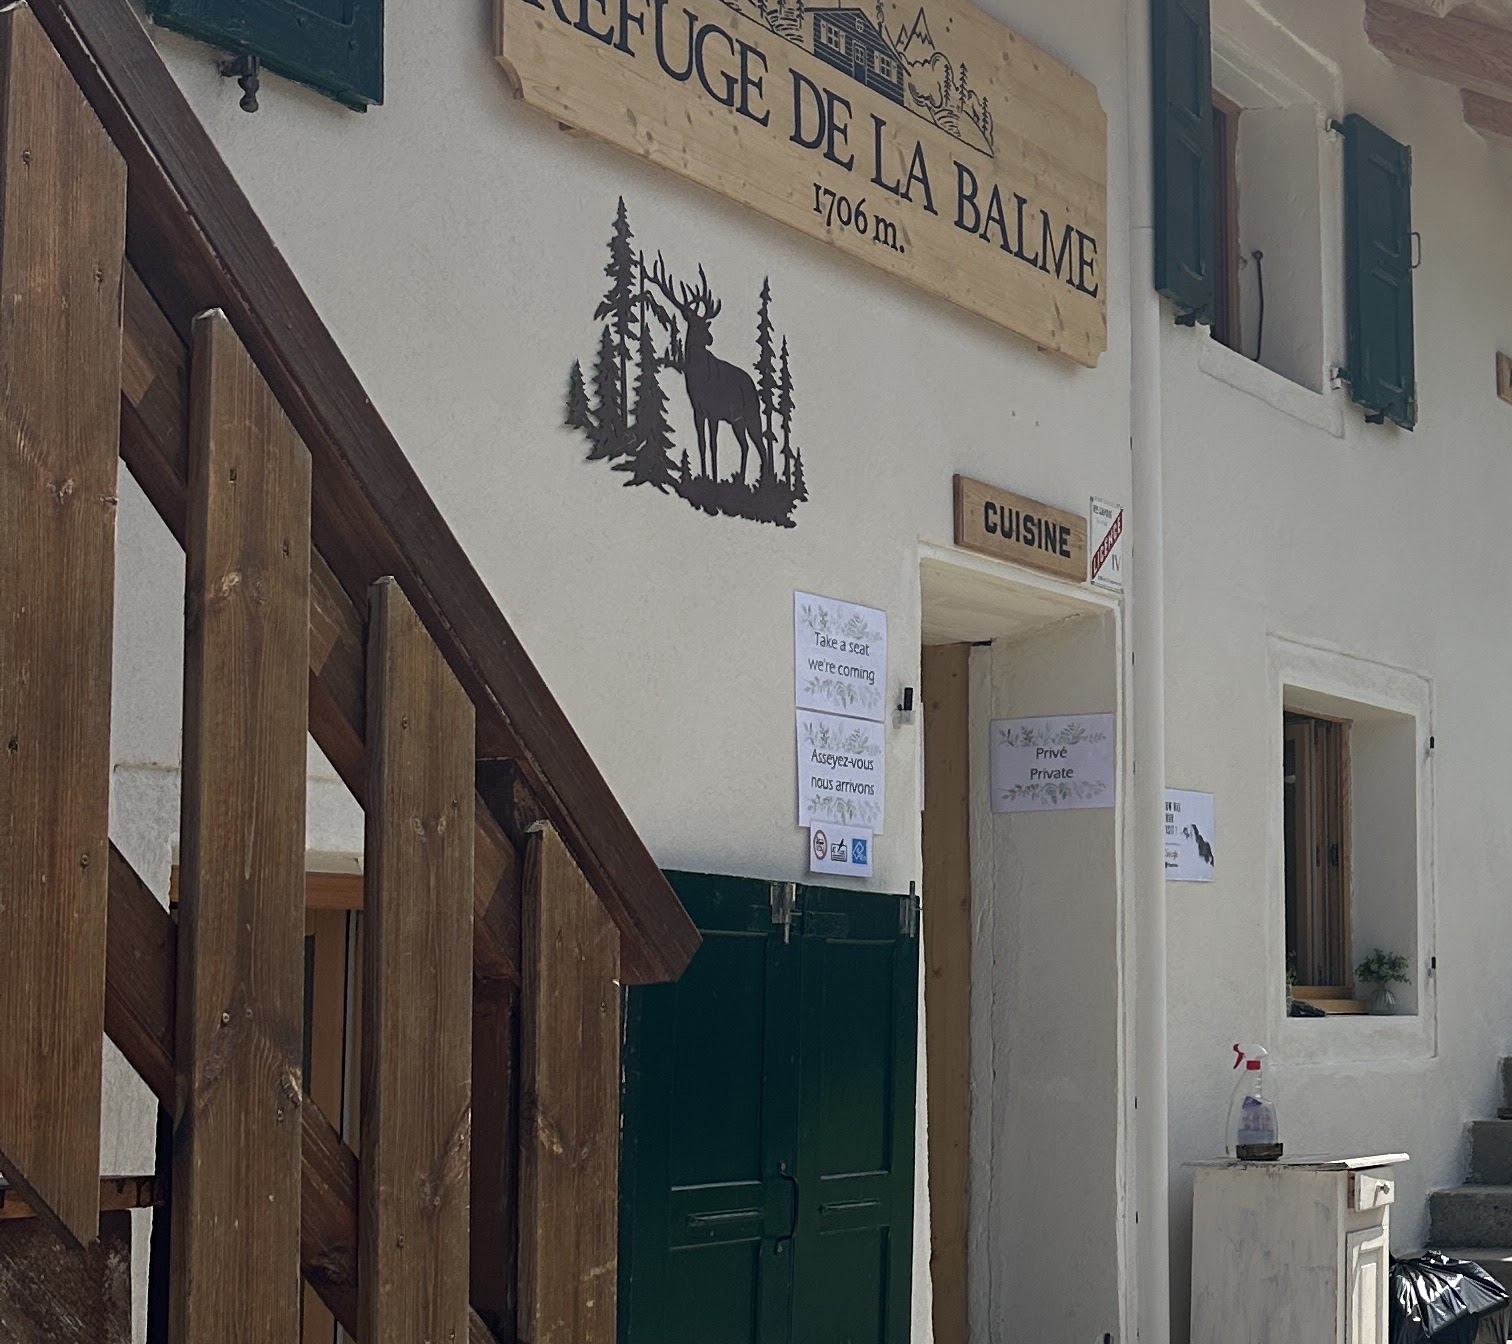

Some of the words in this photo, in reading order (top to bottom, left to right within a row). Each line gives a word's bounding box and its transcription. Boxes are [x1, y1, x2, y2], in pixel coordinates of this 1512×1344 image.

[789, 66, 856, 173] DE
[870, 112, 939, 217] LA
[952, 159, 1101, 300] BALME
[813, 182, 869, 236] 1706
[873, 211, 906, 256] m.
[983, 500, 1072, 559] CUISINE
[814, 631, 838, 650] Take
[839, 640, 847, 652] a
[848, 641, 870, 657] seat
[808, 657, 836, 674] we're
[837, 663, 876, 686] coming
[810, 748, 874, 771] Asseyez-vous
[1035, 745, 1069, 761] Privé
[810, 776, 834, 791] nous
[835, 779, 875, 796] arrivons
[1029, 765, 1074, 781] Private
